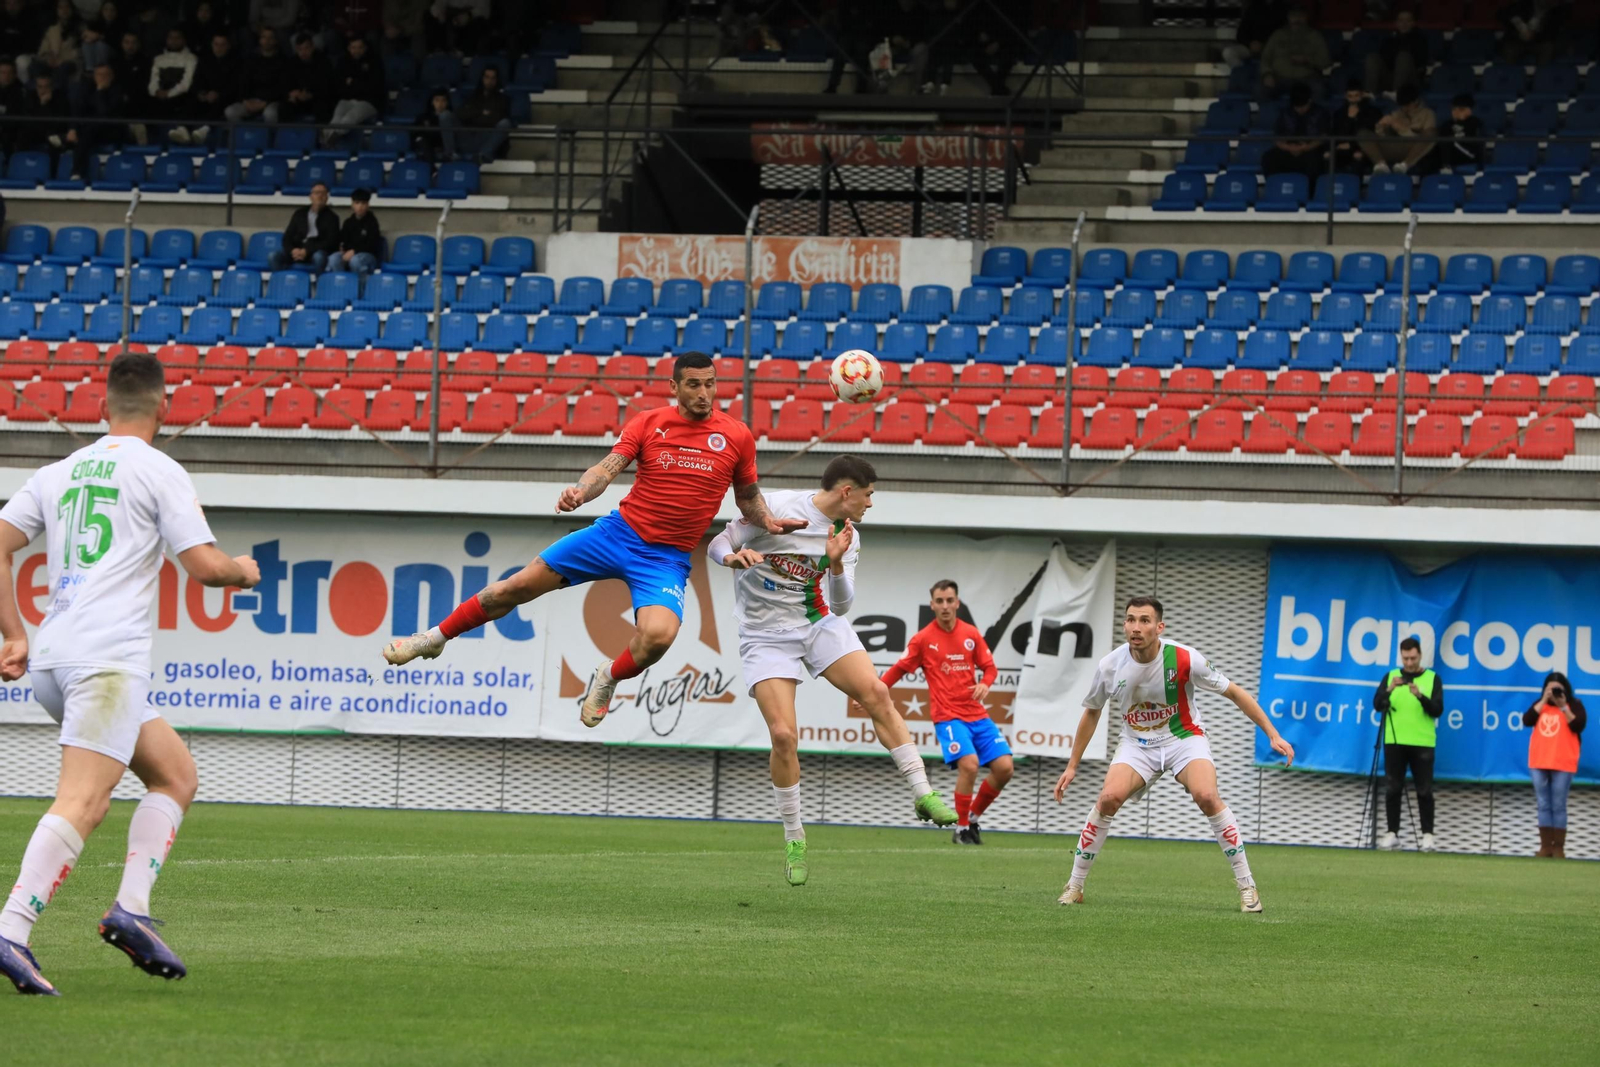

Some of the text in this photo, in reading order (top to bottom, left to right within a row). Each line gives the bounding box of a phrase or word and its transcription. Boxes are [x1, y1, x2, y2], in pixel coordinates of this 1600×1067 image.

[620, 237, 671, 281] La
[787, 238, 898, 284] Galicia
[677, 461, 713, 472] COSAGA
[58, 484, 120, 569] 15
[164, 659, 534, 691] gasoleo, biomasa, enerxía solar,
[269, 695, 281, 709] e
[290, 689, 332, 711] aire
[340, 692, 508, 717] acondicionado
[1122, 703, 1178, 725] PRÉSIDENT
